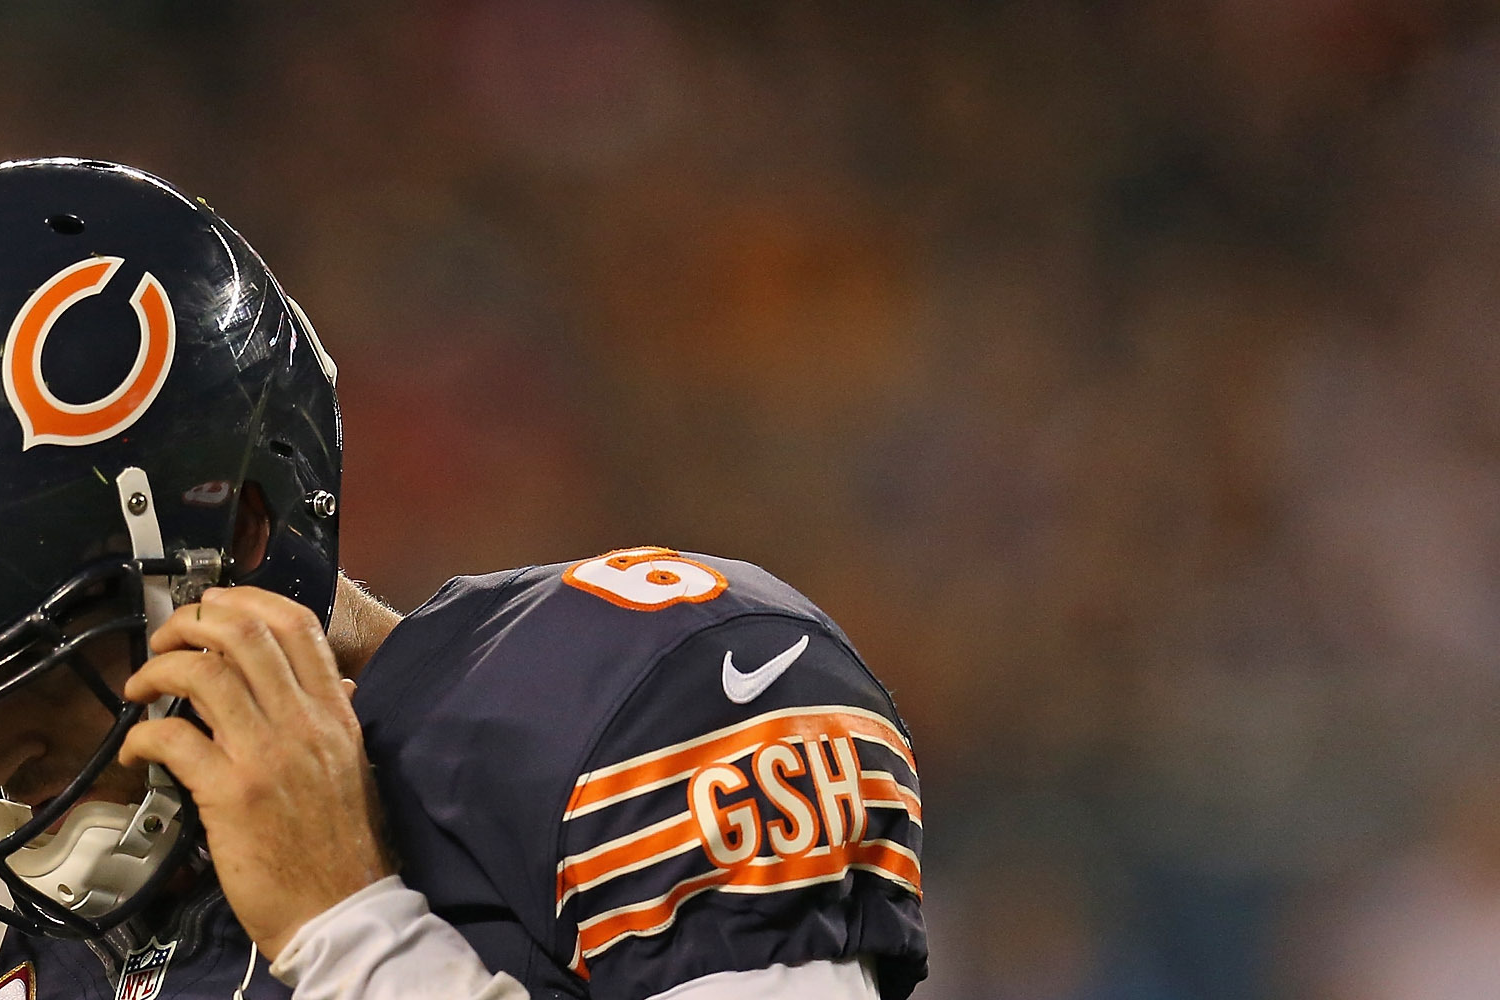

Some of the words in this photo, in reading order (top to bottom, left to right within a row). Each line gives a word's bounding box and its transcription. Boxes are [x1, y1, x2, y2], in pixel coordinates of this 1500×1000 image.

[3, 257, 176, 452] C
[562, 546, 729, 612] 6
[687, 733, 866, 869] GSH
[120, 969, 155, 1000] NFL
